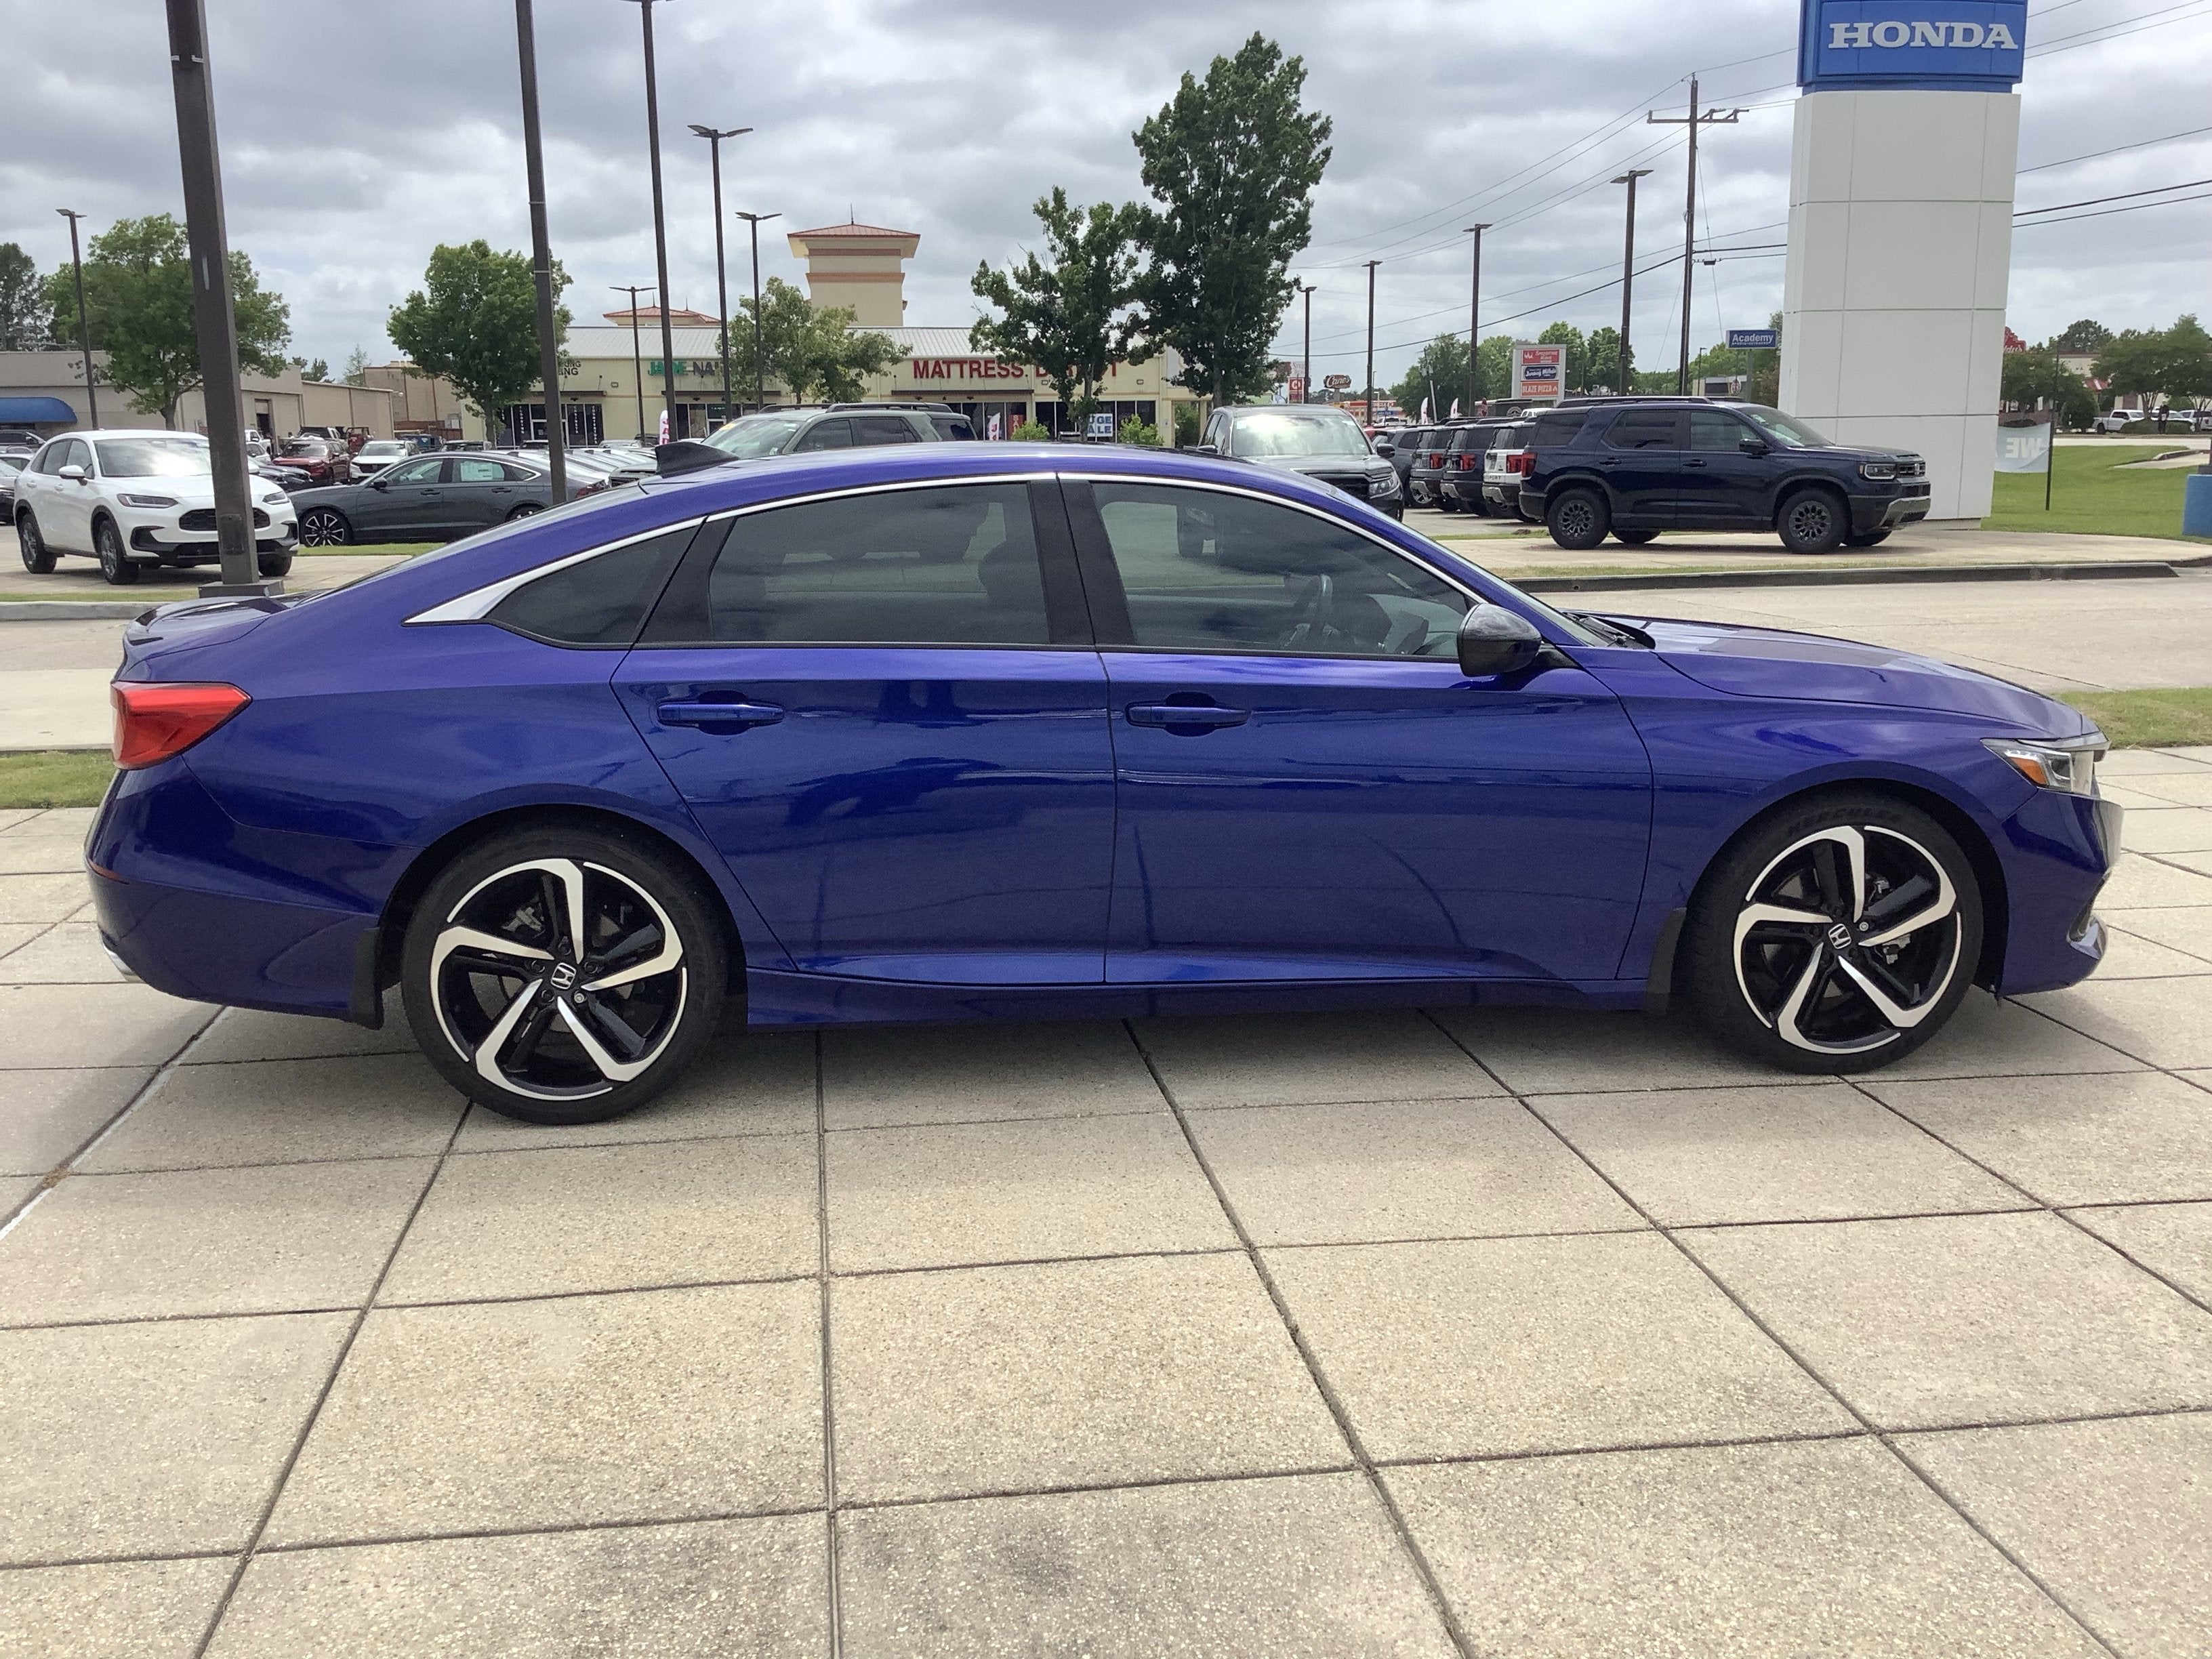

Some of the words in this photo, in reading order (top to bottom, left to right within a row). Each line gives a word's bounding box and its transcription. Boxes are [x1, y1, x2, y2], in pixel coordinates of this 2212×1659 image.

[1828, 22, 2018, 49] HONDA
[1732, 333, 1774, 344] Academy
[914, 360, 1024, 379] MATTRESS
[1088, 425, 1111, 434] ALE
